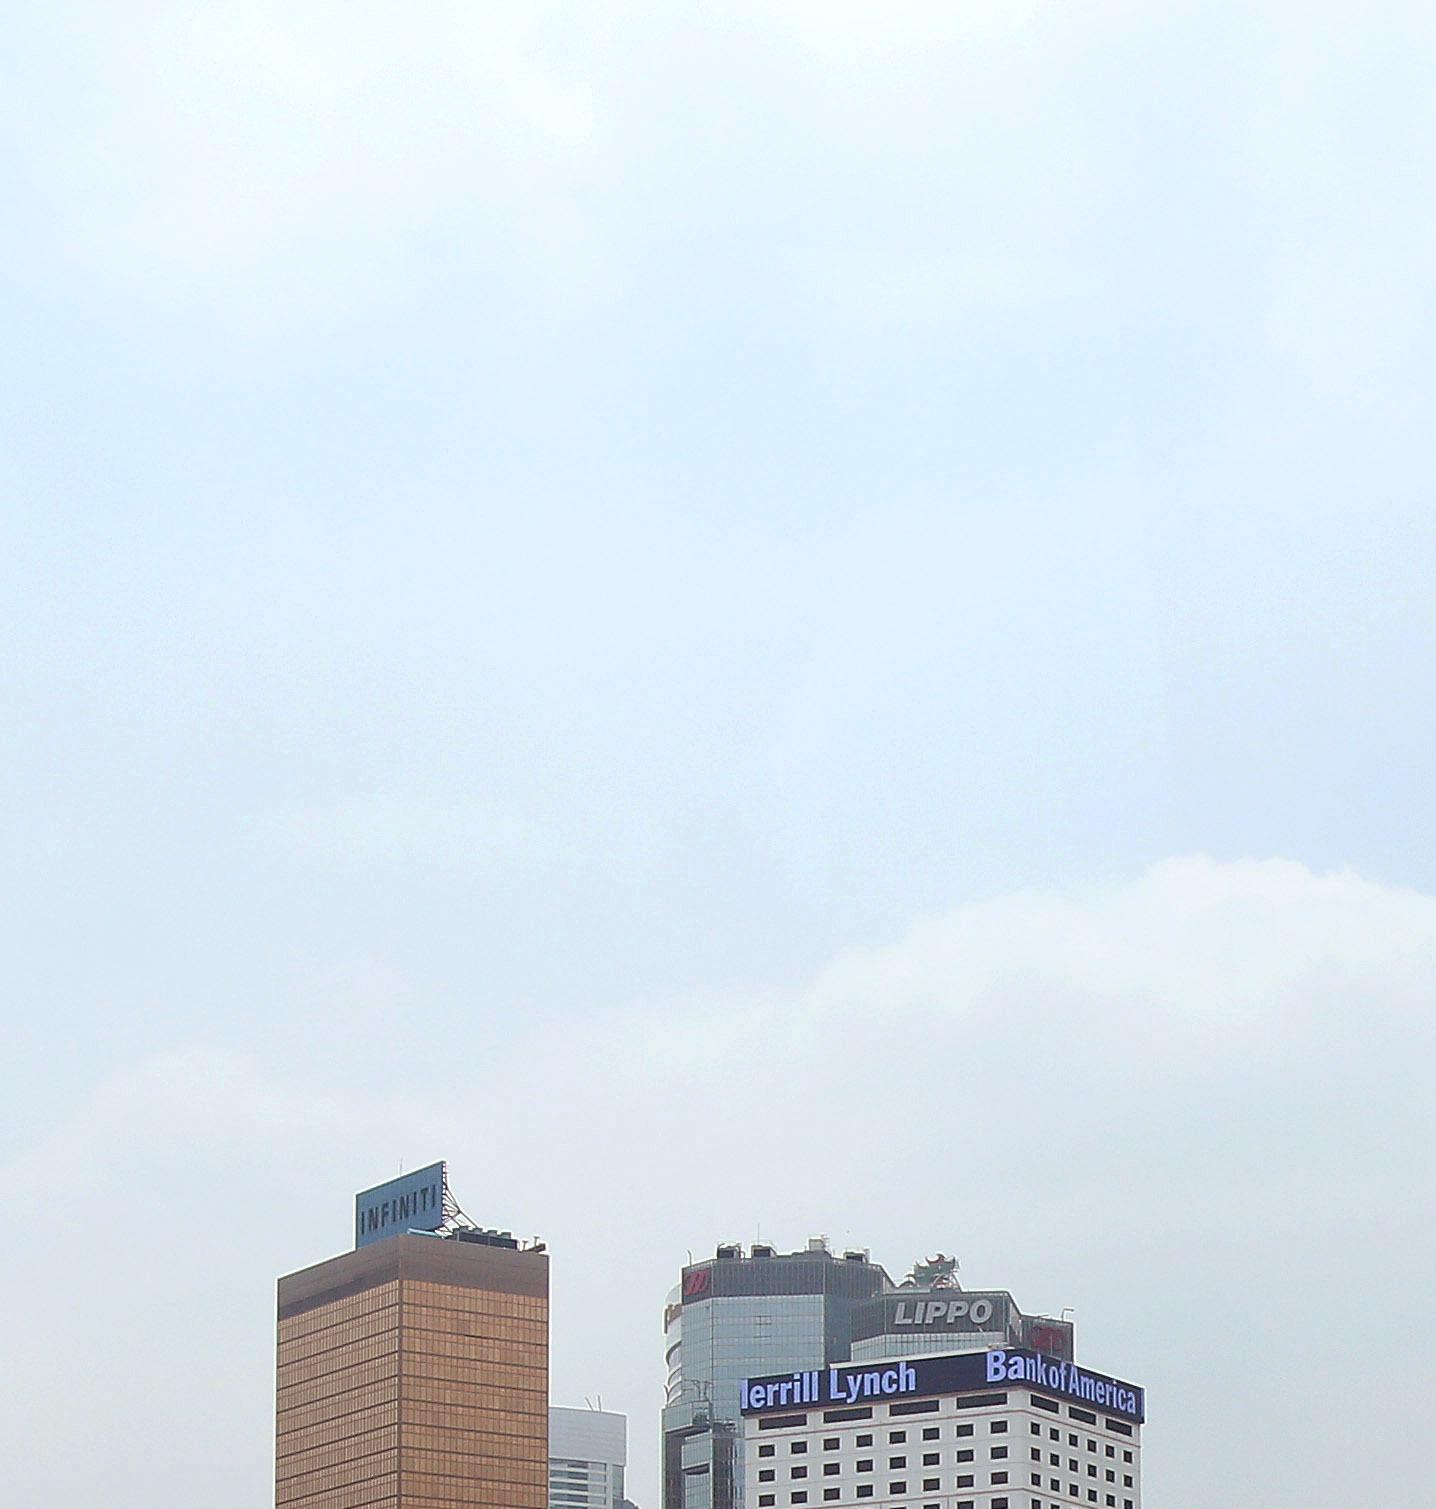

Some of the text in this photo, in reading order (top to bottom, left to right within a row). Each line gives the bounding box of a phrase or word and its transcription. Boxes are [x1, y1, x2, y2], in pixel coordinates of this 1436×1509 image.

[361, 1184, 436, 1235] INFINITI
[894, 1299, 993, 1325] LIPPO
[829, 1361, 916, 1403] Lynch
[986, 1350, 1136, 1415] Bank of America
